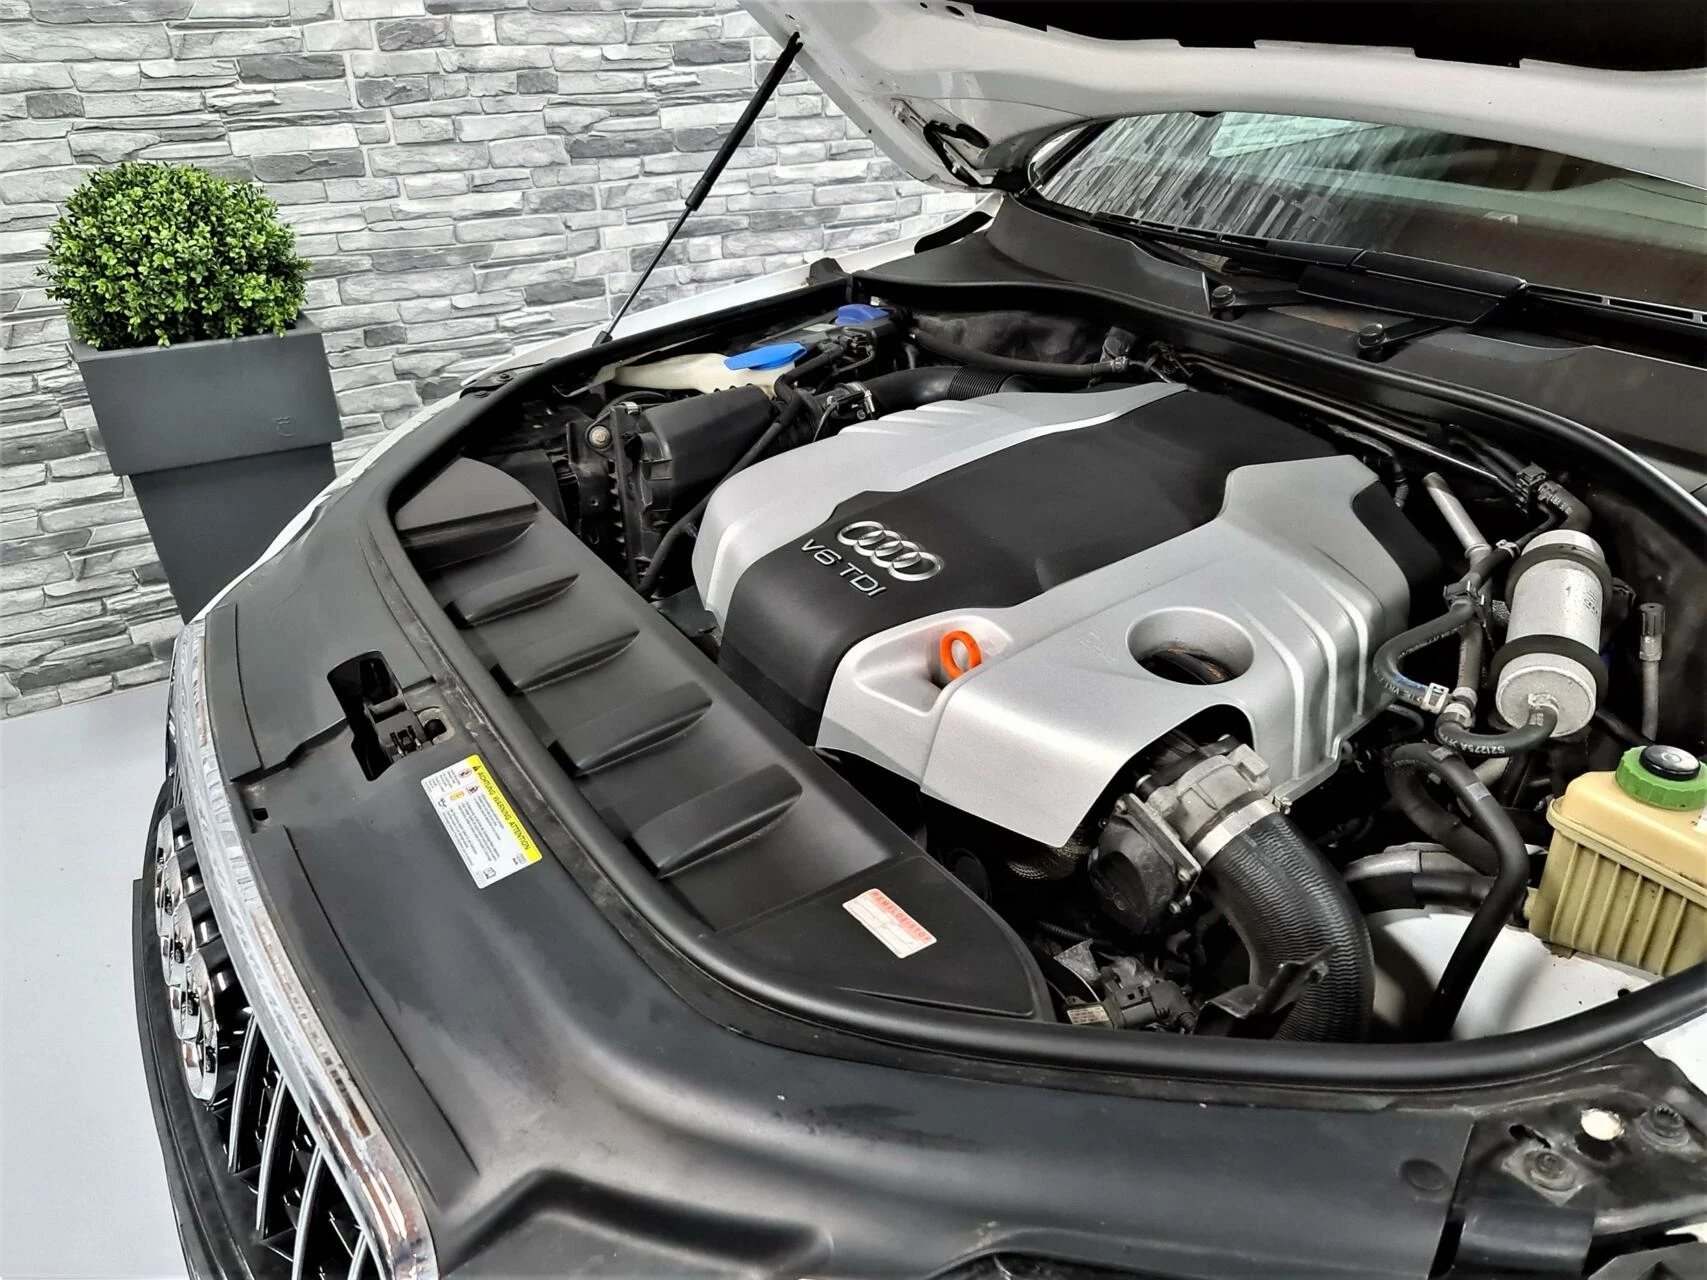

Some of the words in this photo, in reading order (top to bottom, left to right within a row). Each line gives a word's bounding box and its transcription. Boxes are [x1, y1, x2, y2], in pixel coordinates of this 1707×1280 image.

[801, 538, 842, 565] V6
[839, 562, 886, 596] TDI
[477, 772, 496, 796] ACHTUNG
[493, 796, 512, 821] WARNING
[509, 820, 532, 850] ATTENTION
